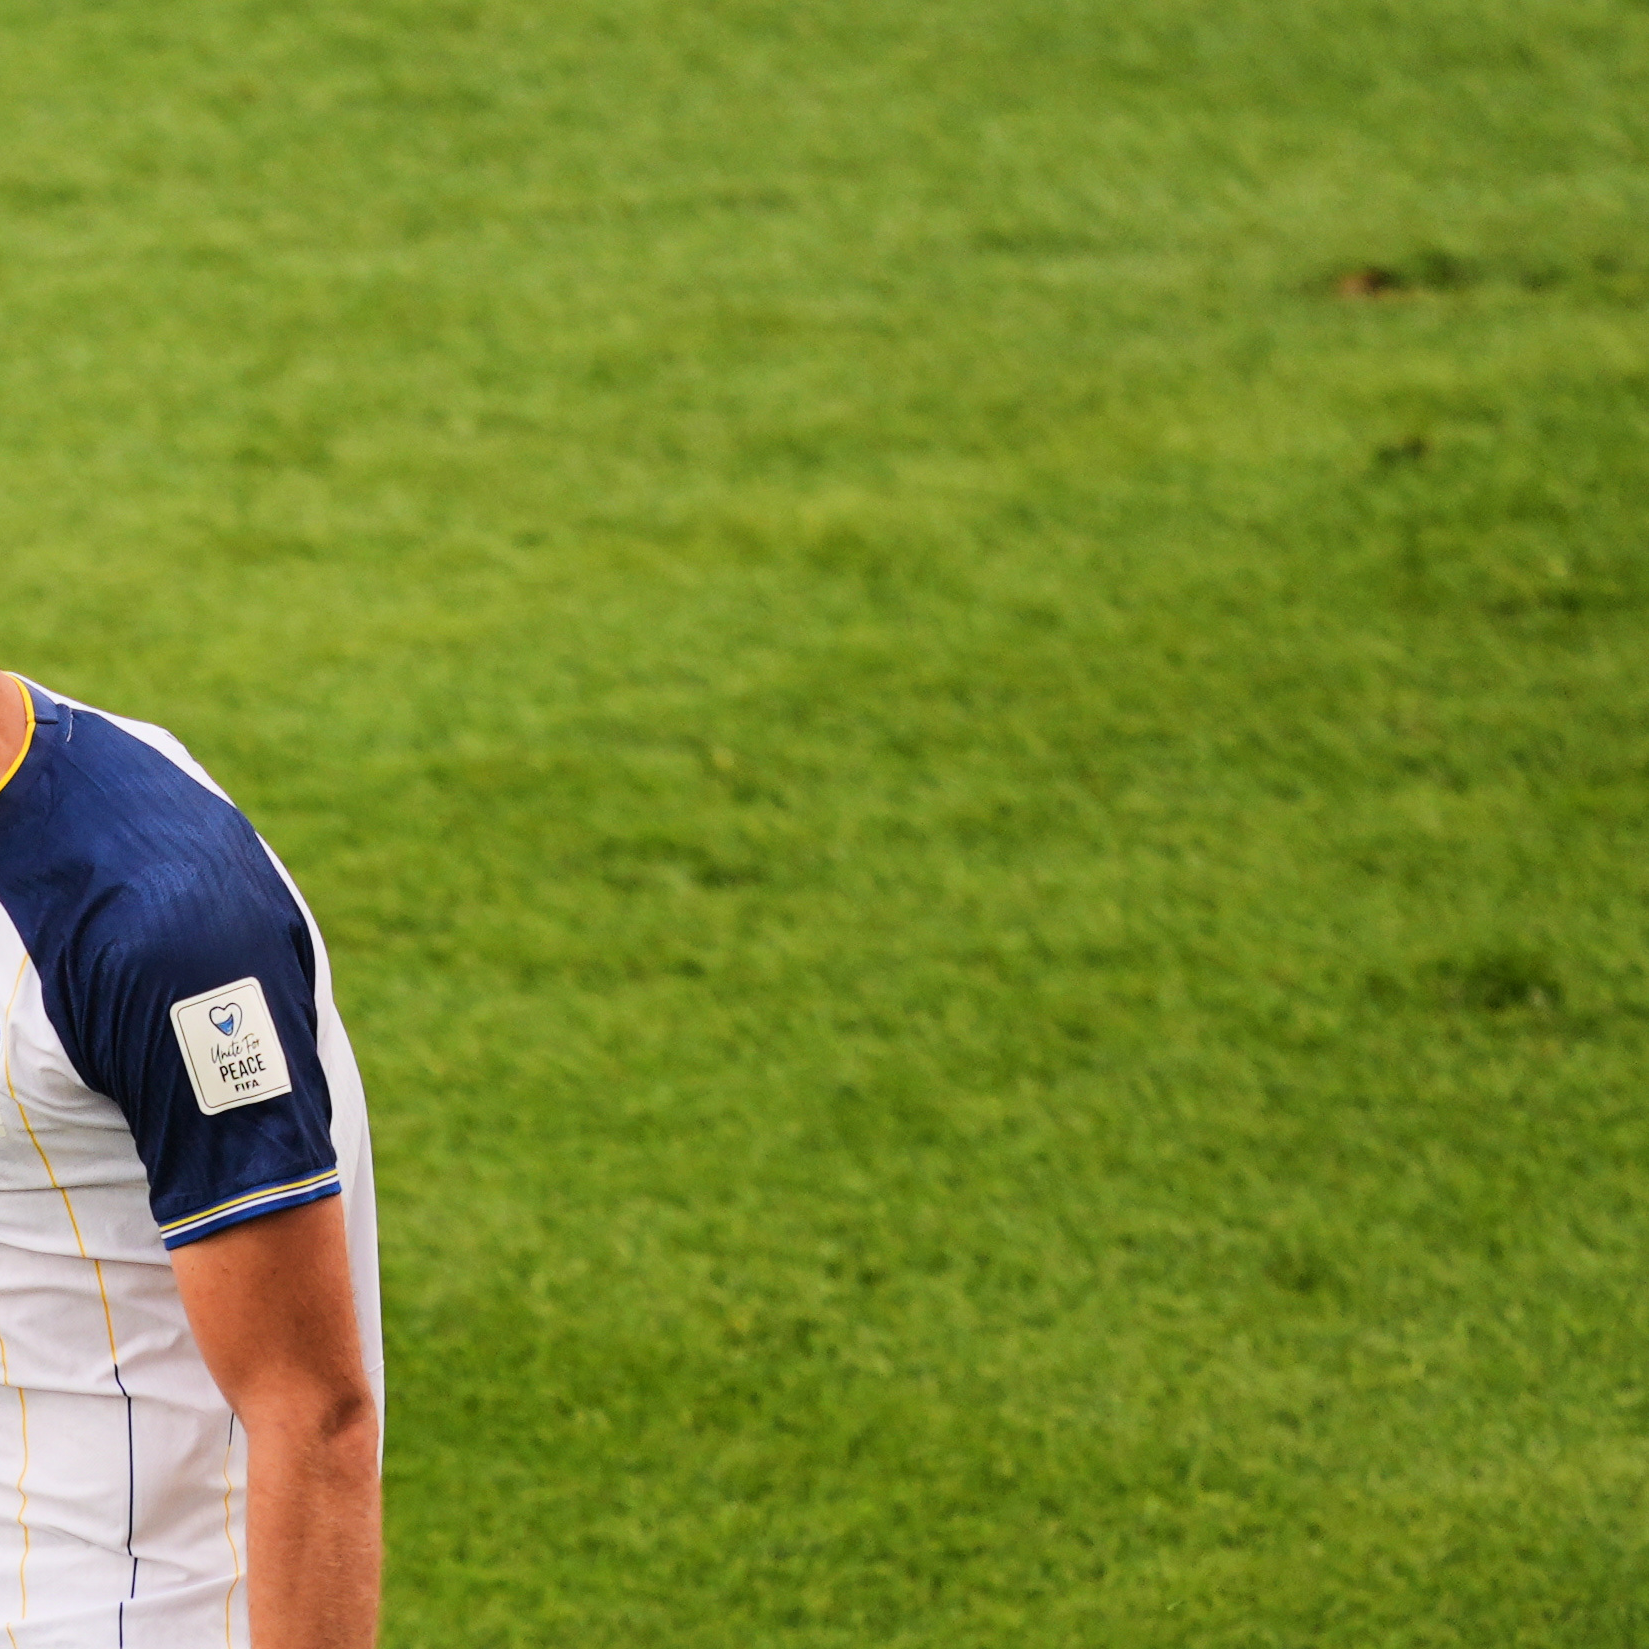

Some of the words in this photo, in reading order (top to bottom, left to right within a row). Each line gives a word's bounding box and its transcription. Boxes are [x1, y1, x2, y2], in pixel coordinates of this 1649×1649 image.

[211, 1042, 242, 1065] Unite
[242, 1032, 260, 1053] For
[219, 1053, 267, 1083] PEACE
[234, 1079, 260, 1092] FIFA
